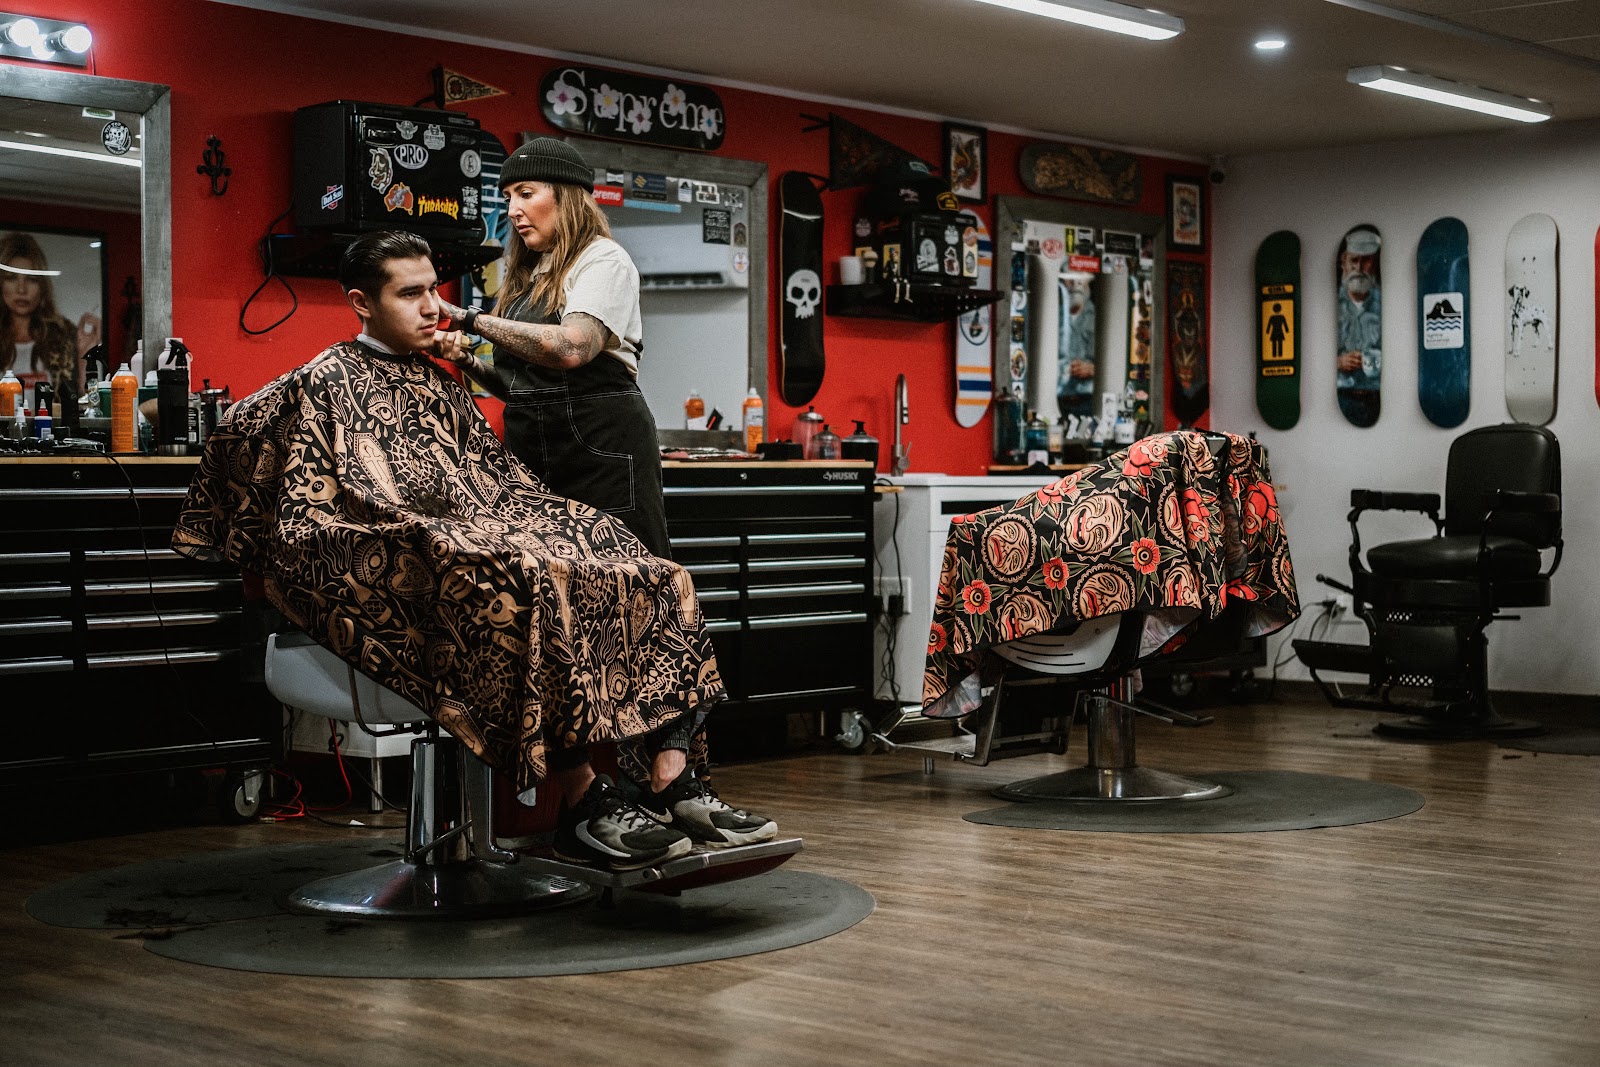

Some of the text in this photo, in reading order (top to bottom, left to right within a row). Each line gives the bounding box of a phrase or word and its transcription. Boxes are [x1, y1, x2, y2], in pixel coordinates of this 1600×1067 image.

[548, 69, 723, 137] Supreme
[400, 145, 424, 164] PRO
[592, 190, 621, 201] preme
[418, 195, 459, 220] THRASHER
[832, 471, 859, 480] HUSKY
